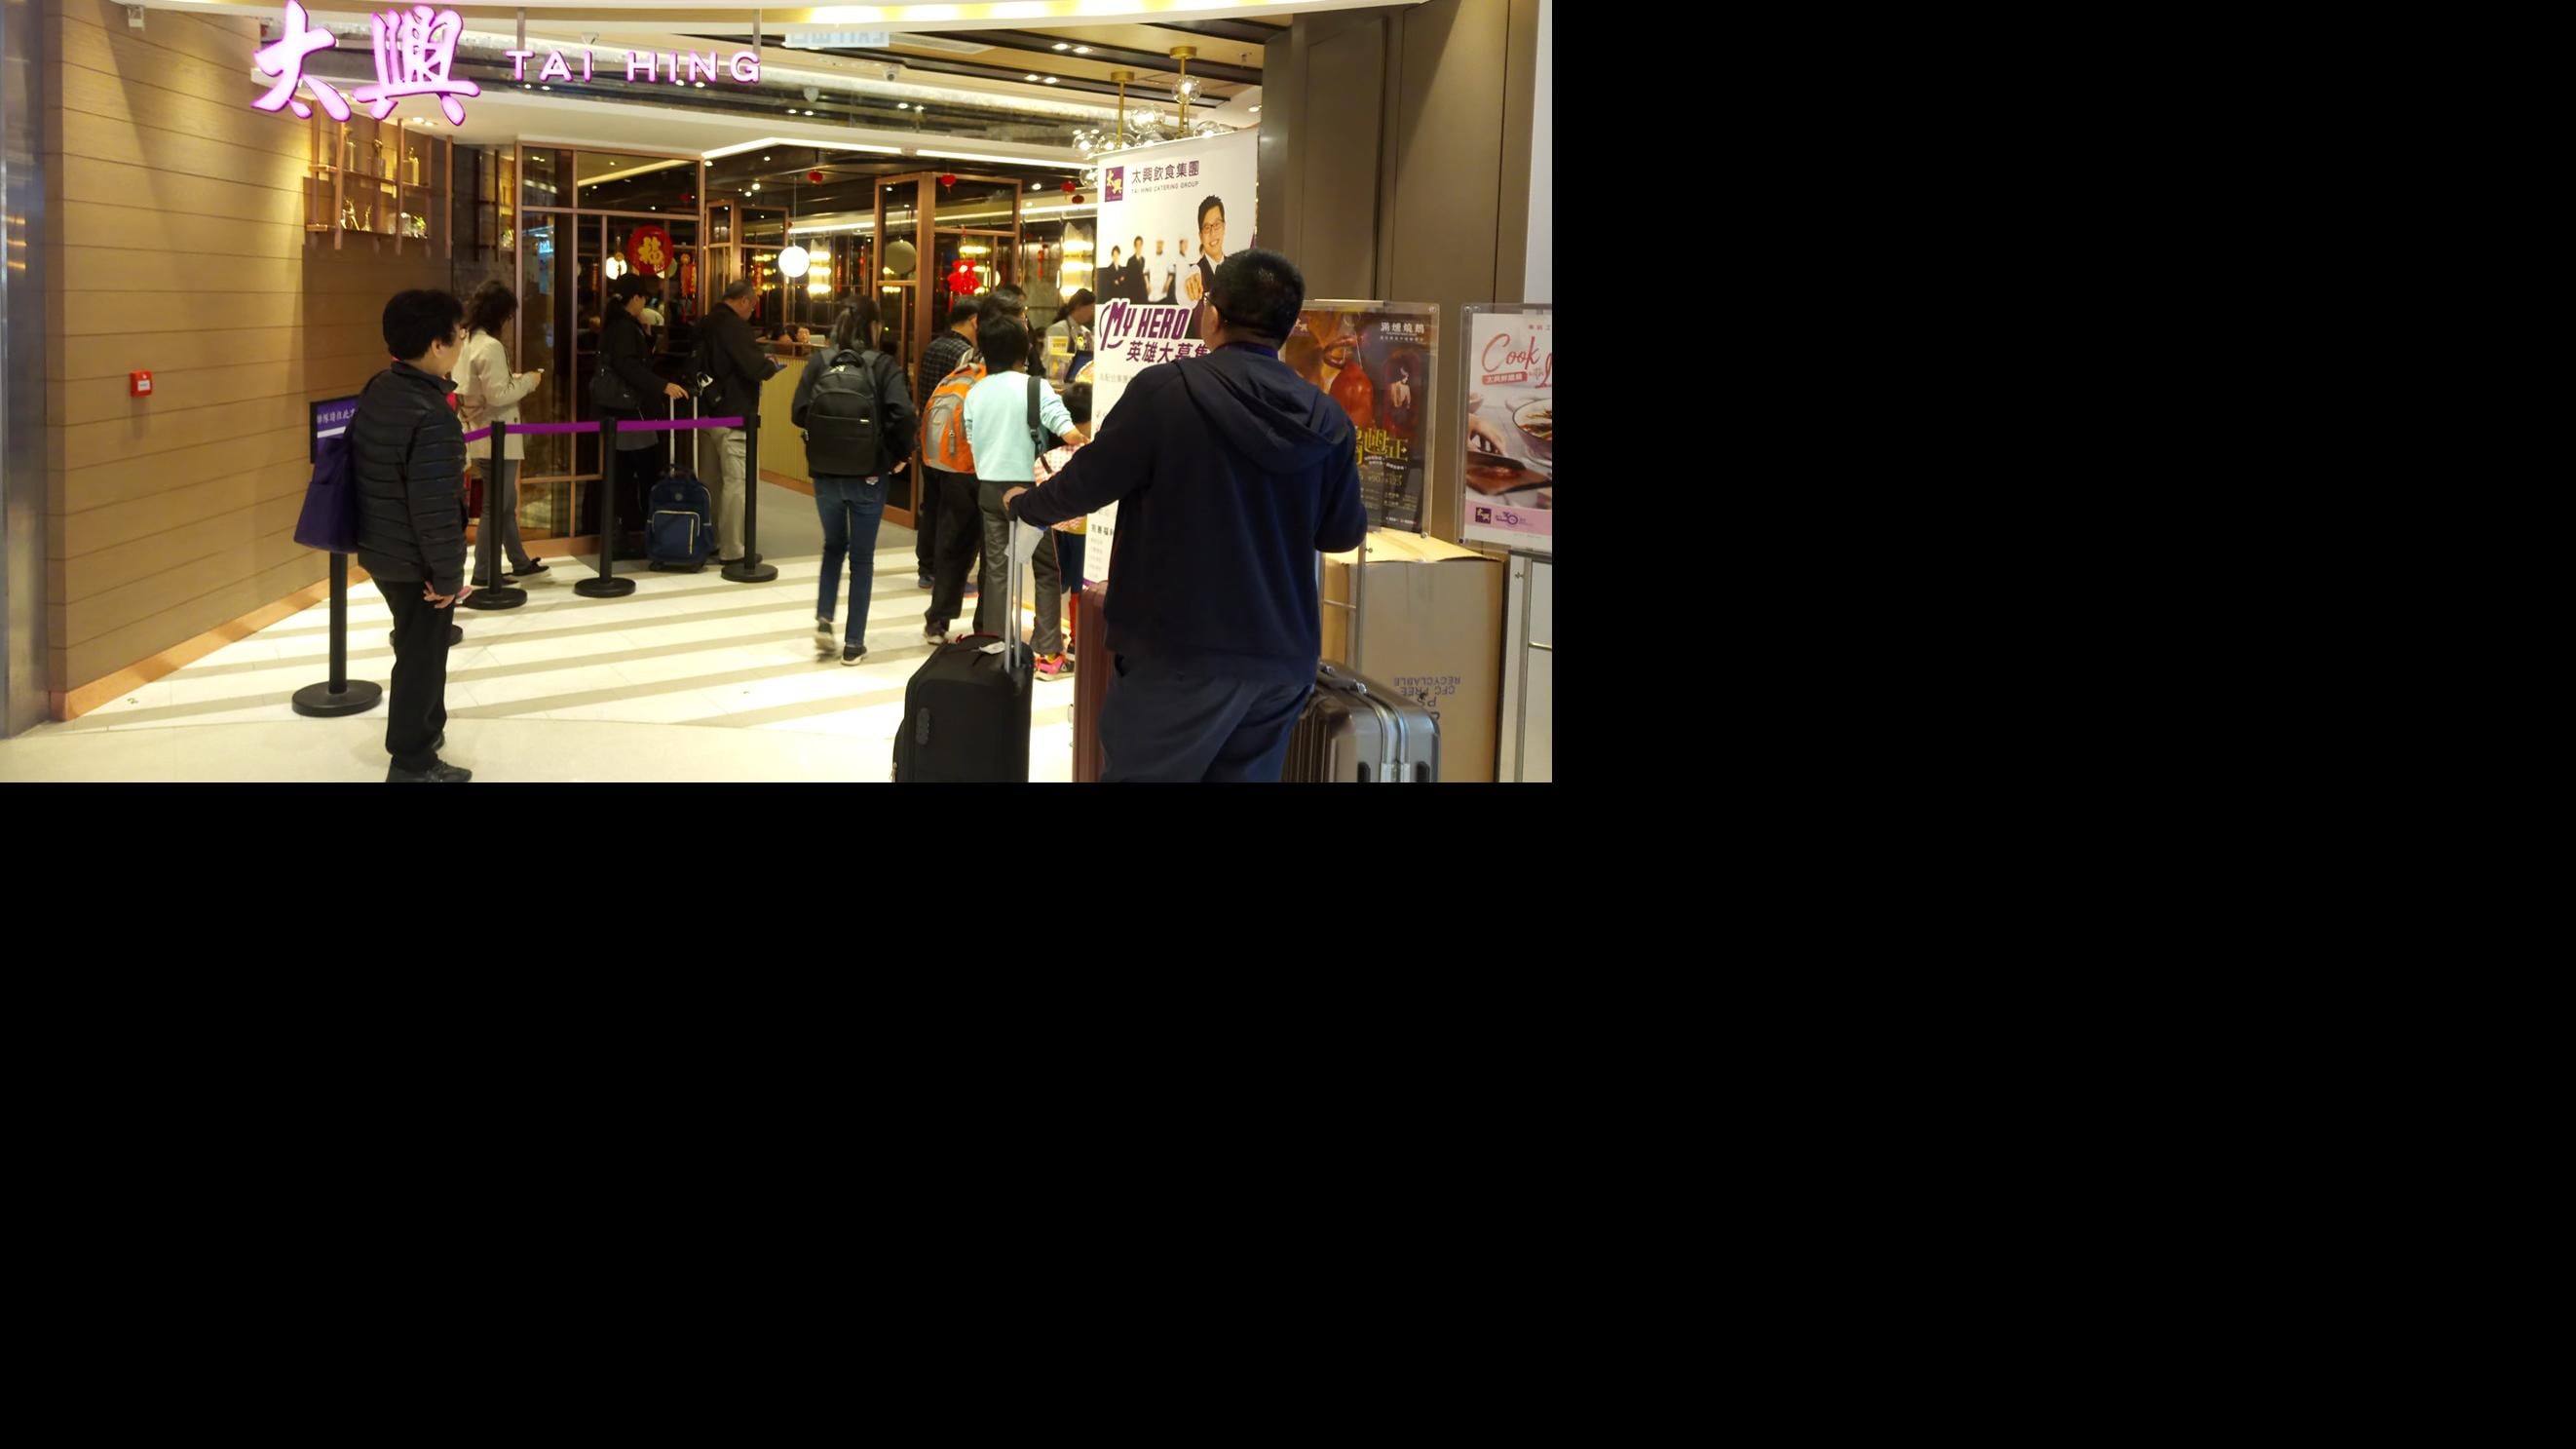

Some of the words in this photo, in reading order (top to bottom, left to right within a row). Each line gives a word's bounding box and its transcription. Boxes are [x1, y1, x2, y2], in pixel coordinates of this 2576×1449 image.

[250, 0, 480, 126] 太興
[505, 50, 594, 82] TAI
[625, 50, 762, 84] HING
[1132, 161, 1199, 183] 太興飲食集團
[1154, 183, 1179, 193] CATERING
[1180, 180, 1199, 189] GROUP
[1136, 308, 1191, 340] HERO
[1482, 333, 1539, 372] Cook
[1394, 677, 1460, 686] RECYCLABLE
[1435, 686, 1456, 695] CFC
